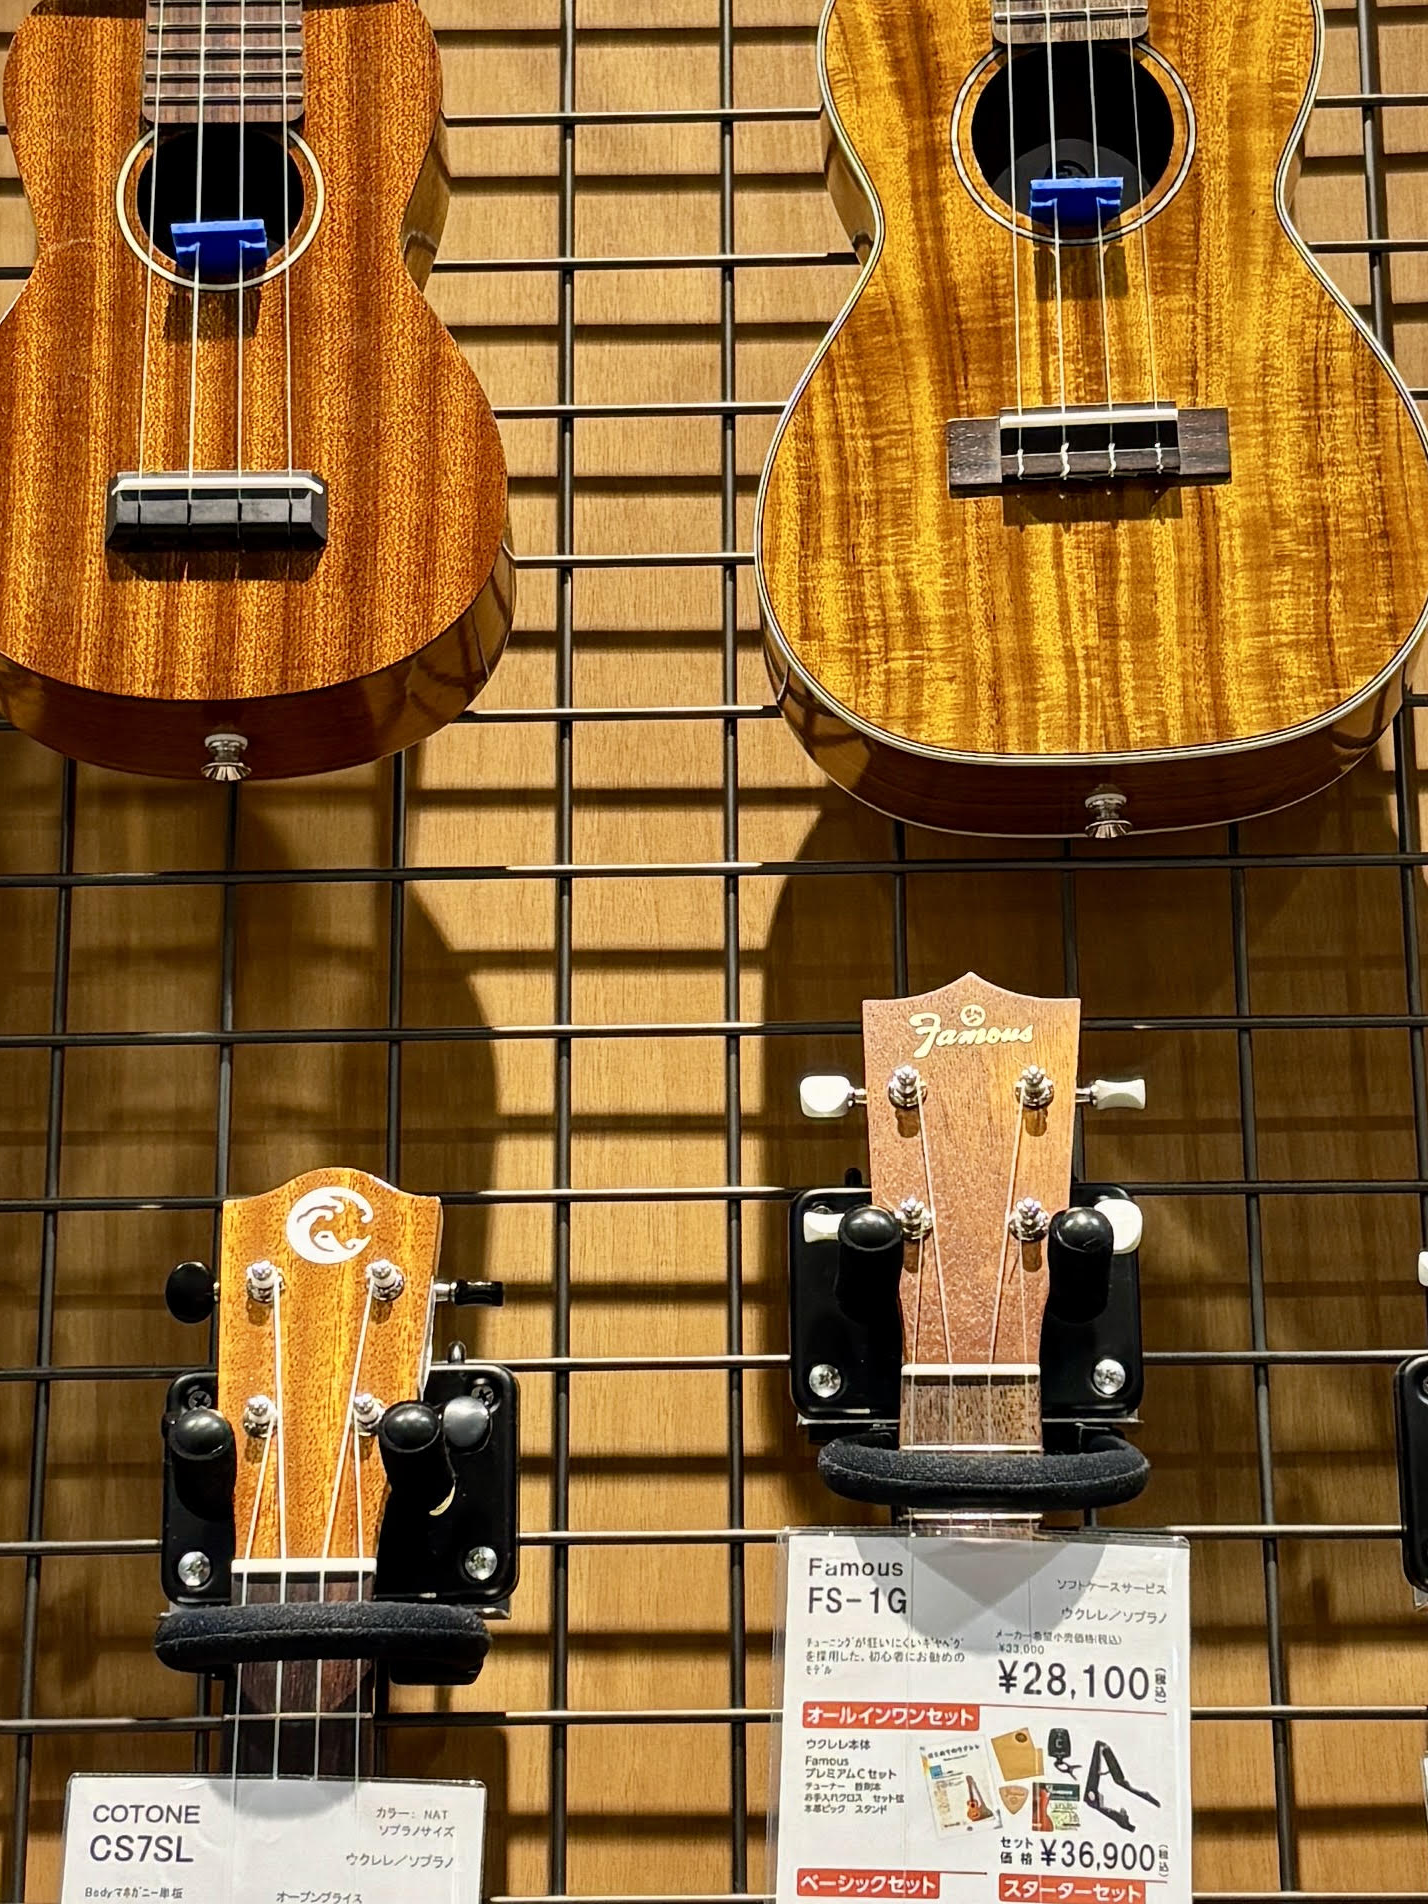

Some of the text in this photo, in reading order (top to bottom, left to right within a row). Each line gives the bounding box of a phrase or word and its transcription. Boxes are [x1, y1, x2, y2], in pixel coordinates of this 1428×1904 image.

[908, 1012, 1034, 1059] Famous
[809, 1557, 904, 1578] Famous
[1056, 1577, 1166, 1595] ソフトケースサービス
[808, 1585, 908, 1616] FS-1G
[997, 1660, 1149, 1701] ¥28,100
[806, 1705, 973, 1727] オールインワンセット
[92, 1804, 201, 1824] COTONE
[424, 1809, 447, 1820] NAT
[88, 1833, 194, 1863] CS7SL
[1041, 1840, 1154, 1872] ¥36,900
[799, 1873, 937, 1896] ベーシックセット
[1003, 1880, 1142, 1903] スターターセット
[276, 1890, 362, 1904] オープンプライス
